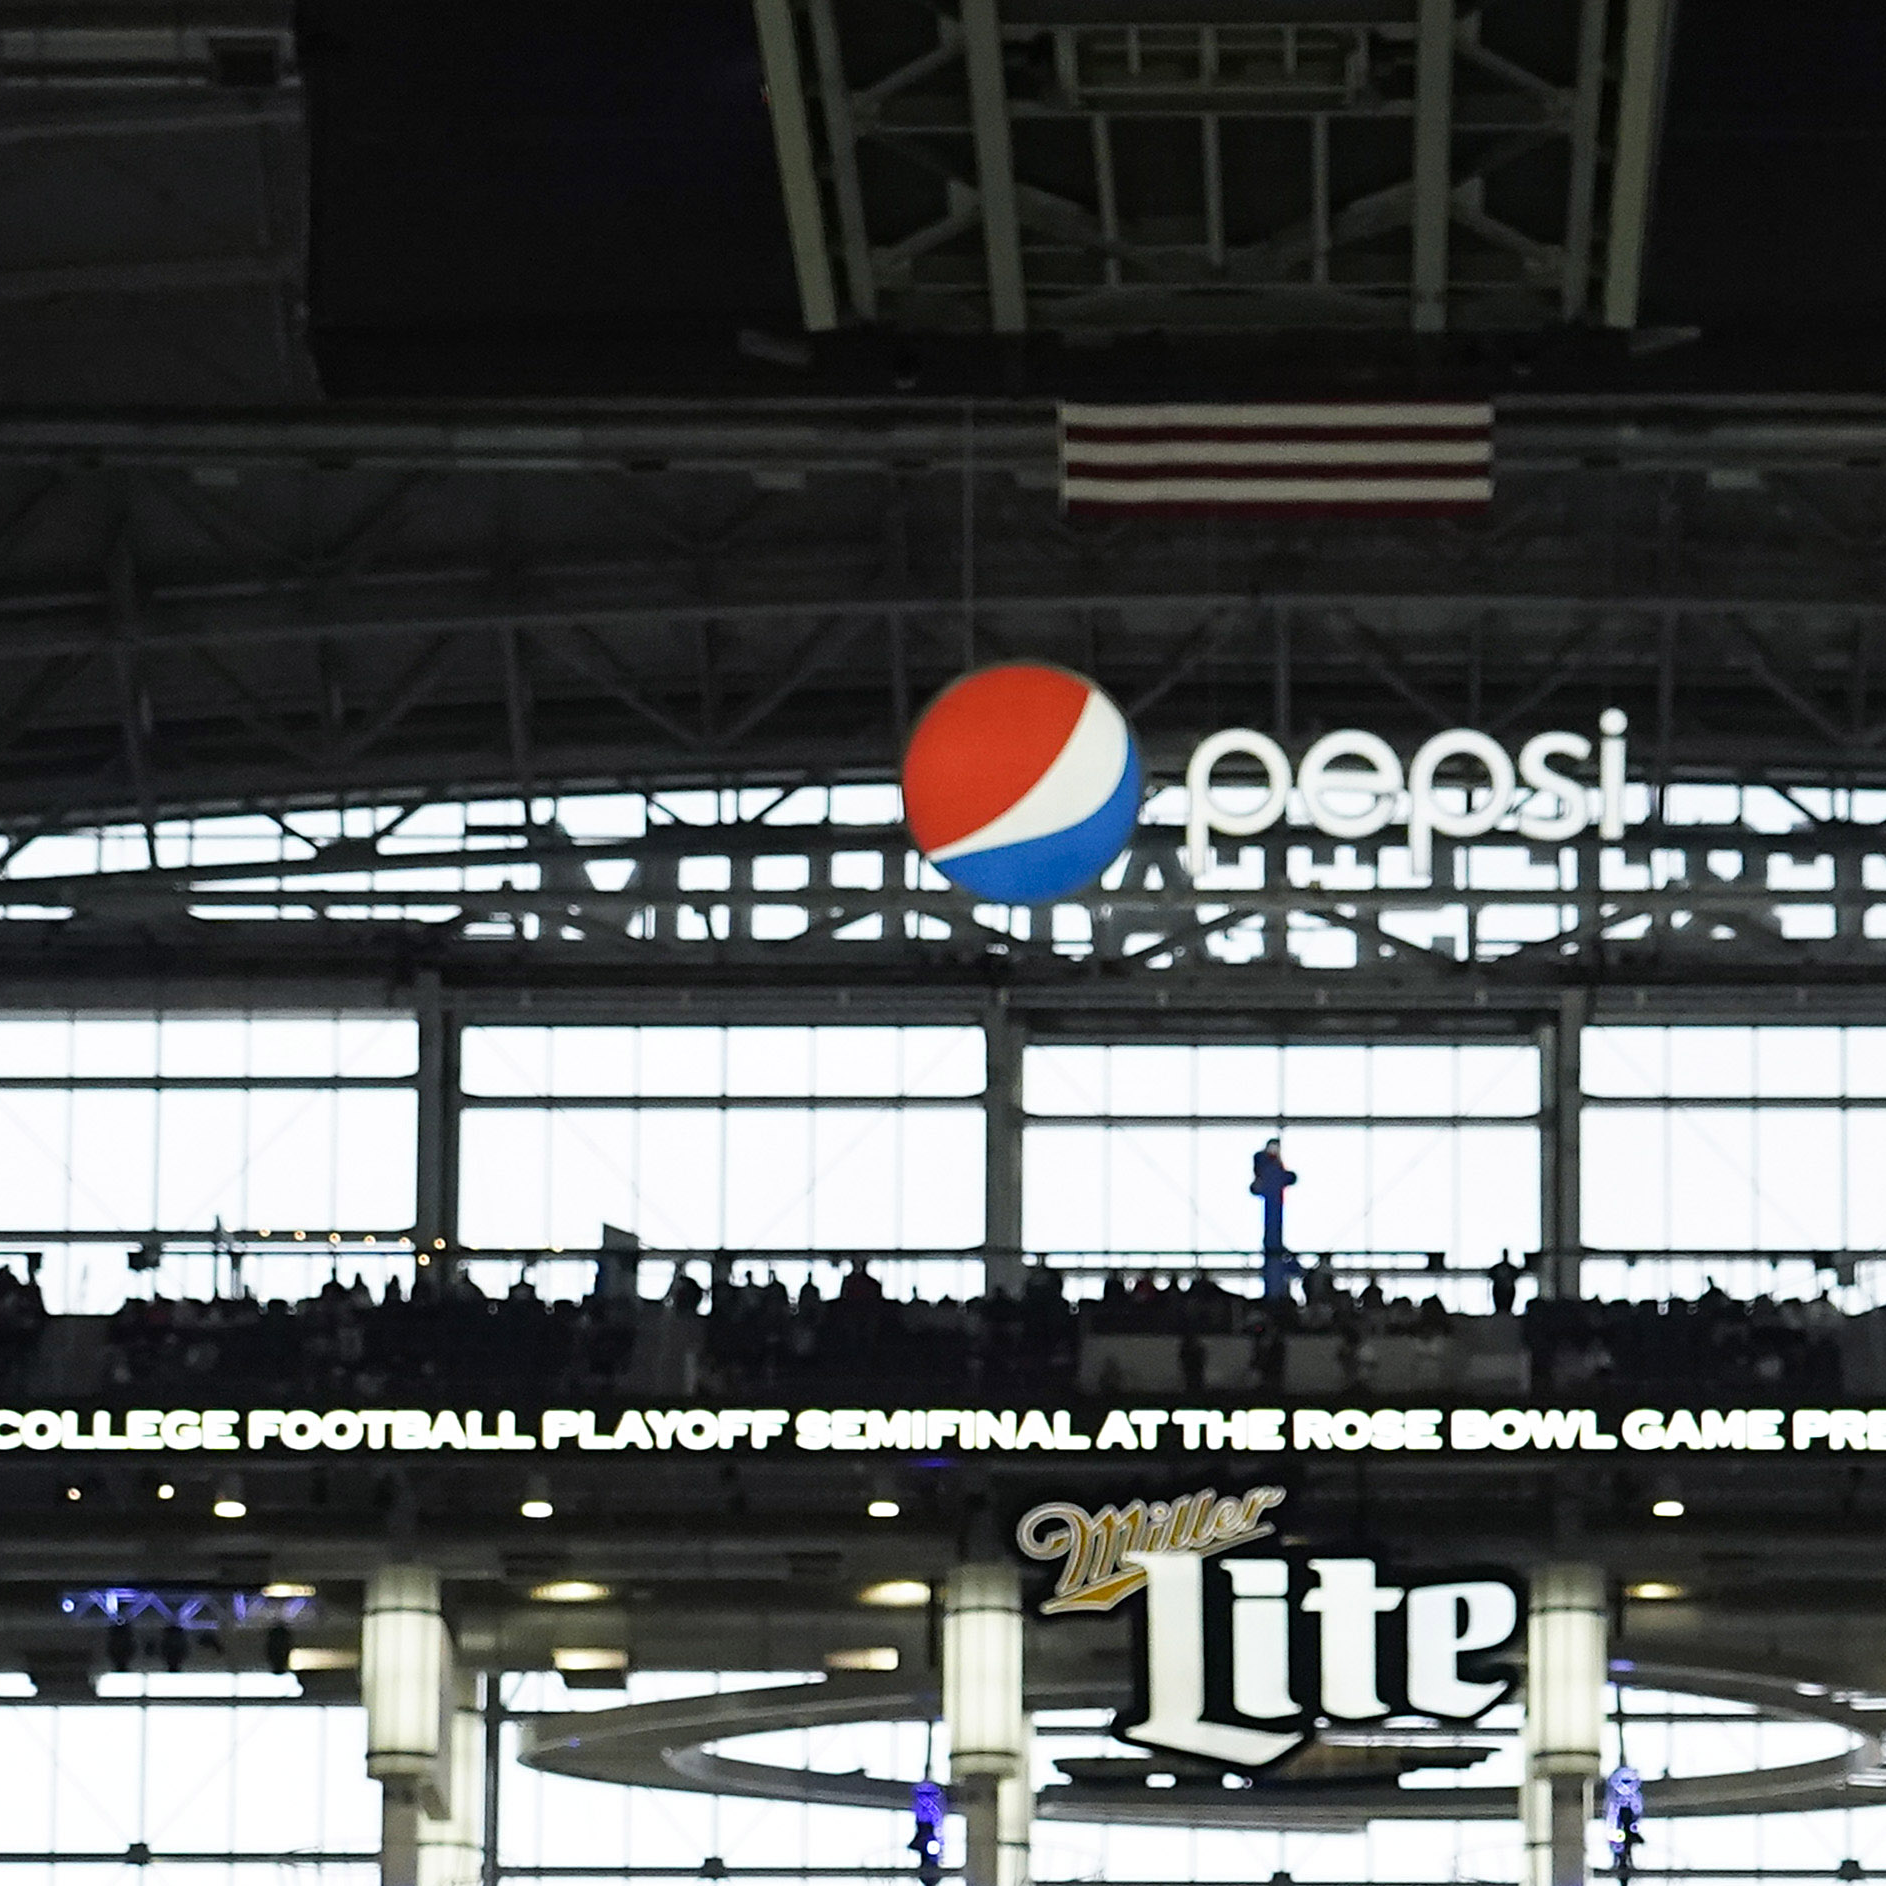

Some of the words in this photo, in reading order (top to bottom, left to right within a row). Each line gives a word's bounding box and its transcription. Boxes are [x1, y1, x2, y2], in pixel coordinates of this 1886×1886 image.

[1185, 707, 1628, 876] pepsi
[248, 1408, 535, 1451] FOOTBALL
[542, 1408, 789, 1451] PLAYOFF
[795, 1408, 1090, 1451] SEMIFINAL
[1096, 1408, 1169, 1451] AT
[1172, 1408, 1284, 1451] THE
[1293, 1408, 1442, 1451] ROSE
[1451, 1408, 1617, 1451] BOWL
[1622, 1408, 1784, 1451] GAME
[1016, 1485, 1288, 1614] Miller
[1124, 1551, 1518, 1768] Lite
